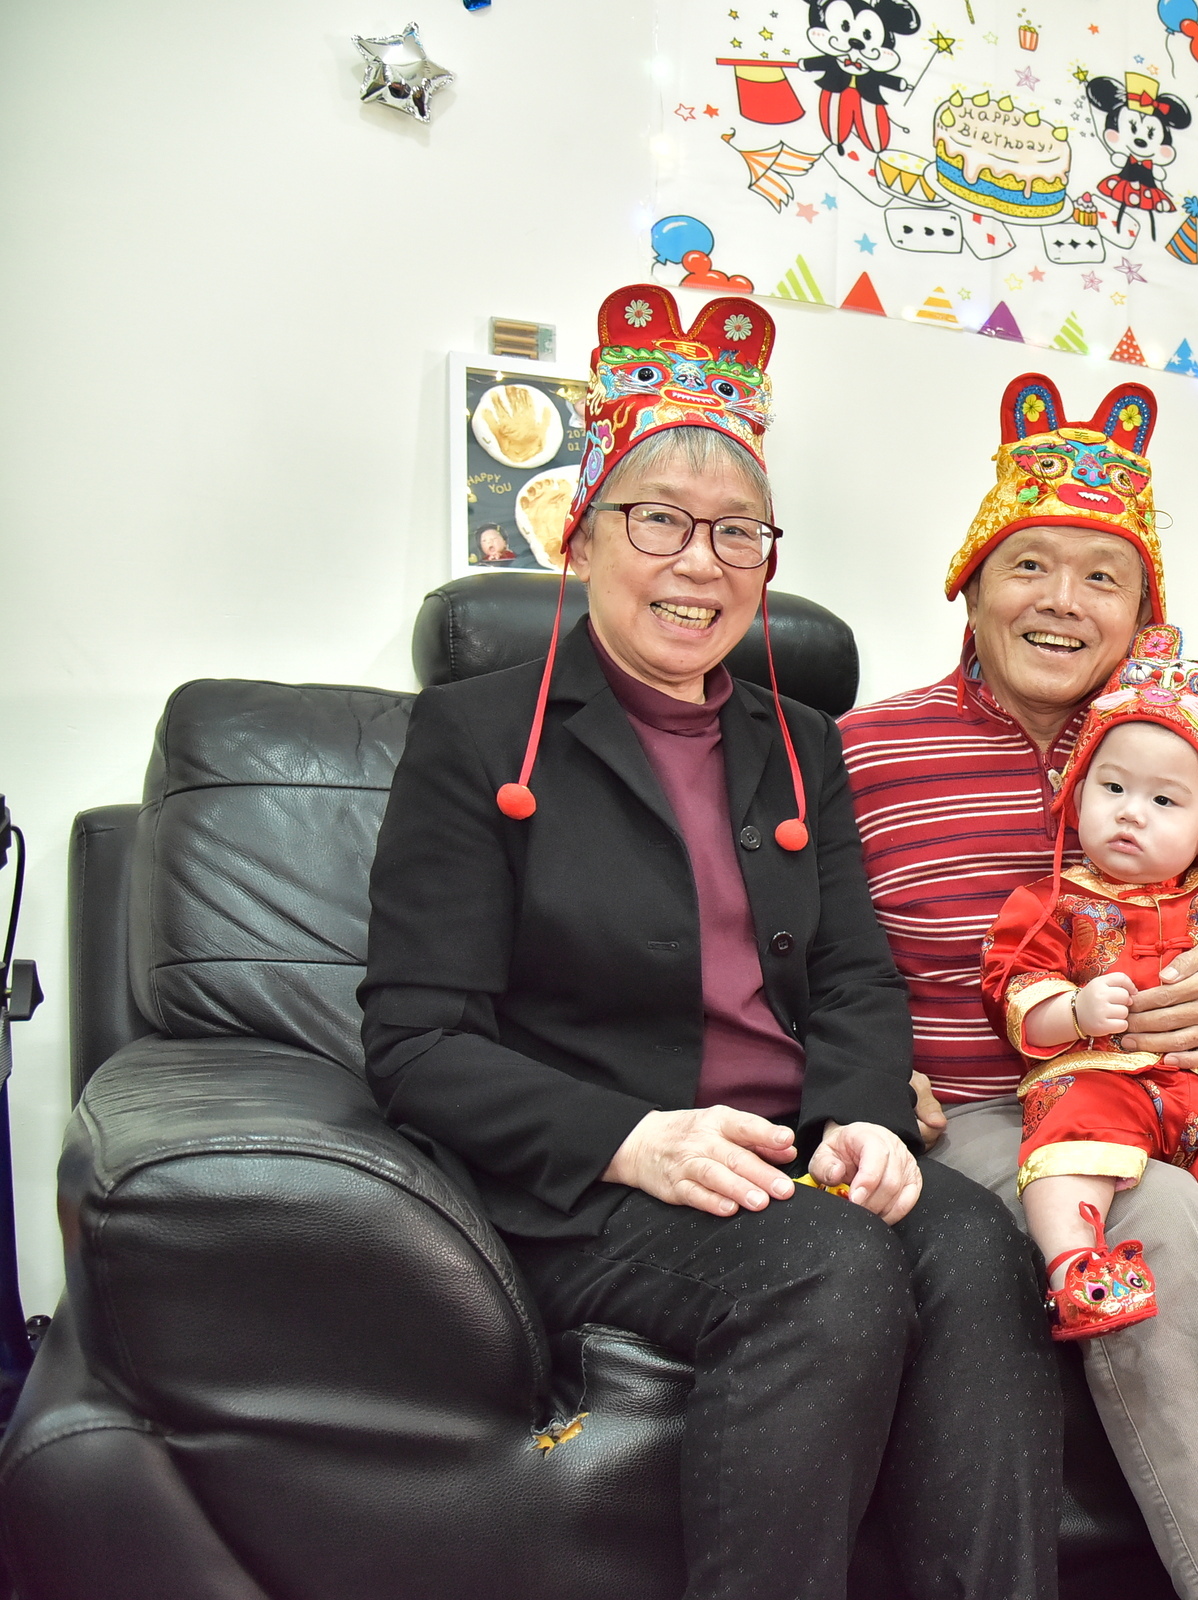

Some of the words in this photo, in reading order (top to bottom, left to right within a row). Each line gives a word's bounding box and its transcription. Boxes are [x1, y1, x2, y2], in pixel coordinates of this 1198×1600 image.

[566, 429, 586, 439] 202
[467, 472, 501, 486] HAPPY
[488, 482, 512, 494] YOU
